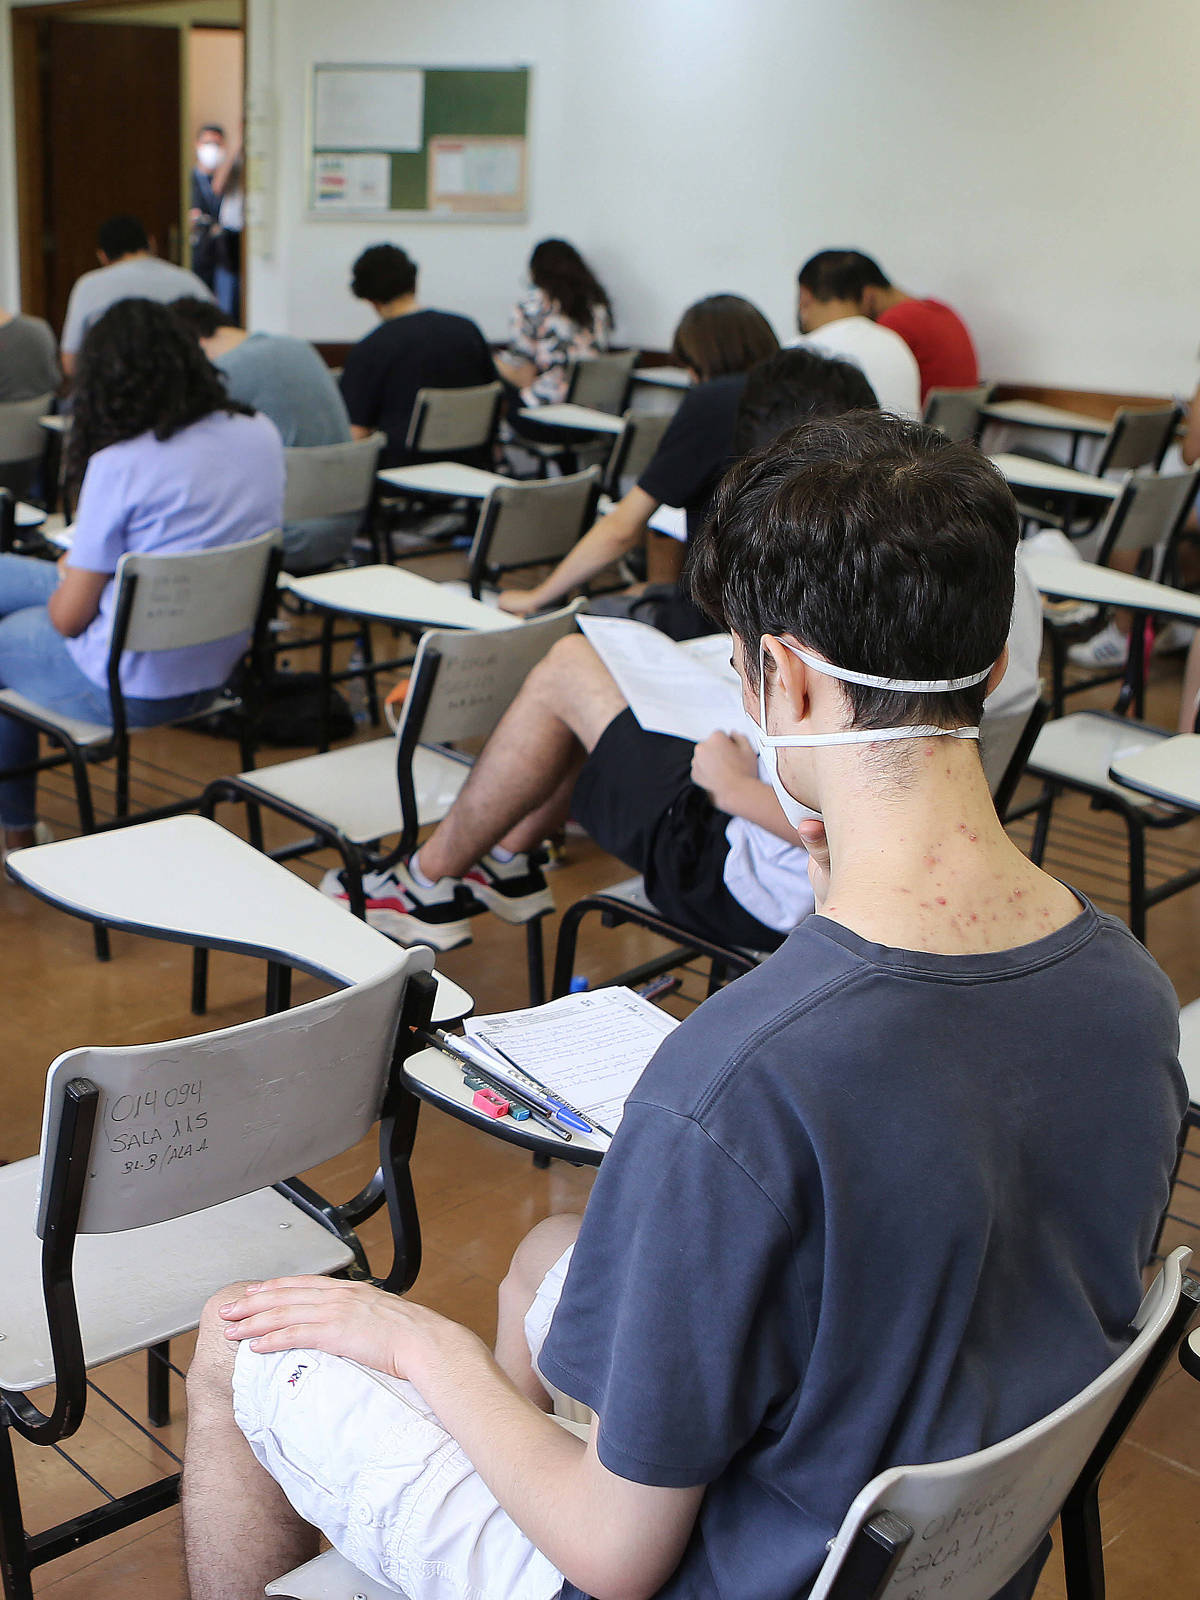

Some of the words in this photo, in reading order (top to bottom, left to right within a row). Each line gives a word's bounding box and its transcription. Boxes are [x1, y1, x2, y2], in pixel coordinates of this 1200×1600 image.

[111, 1090, 158, 1122] 014
[164, 1079, 202, 1108] 094
[110, 1128, 162, 1153] SALA
[172, 1111, 209, 1138] 115
